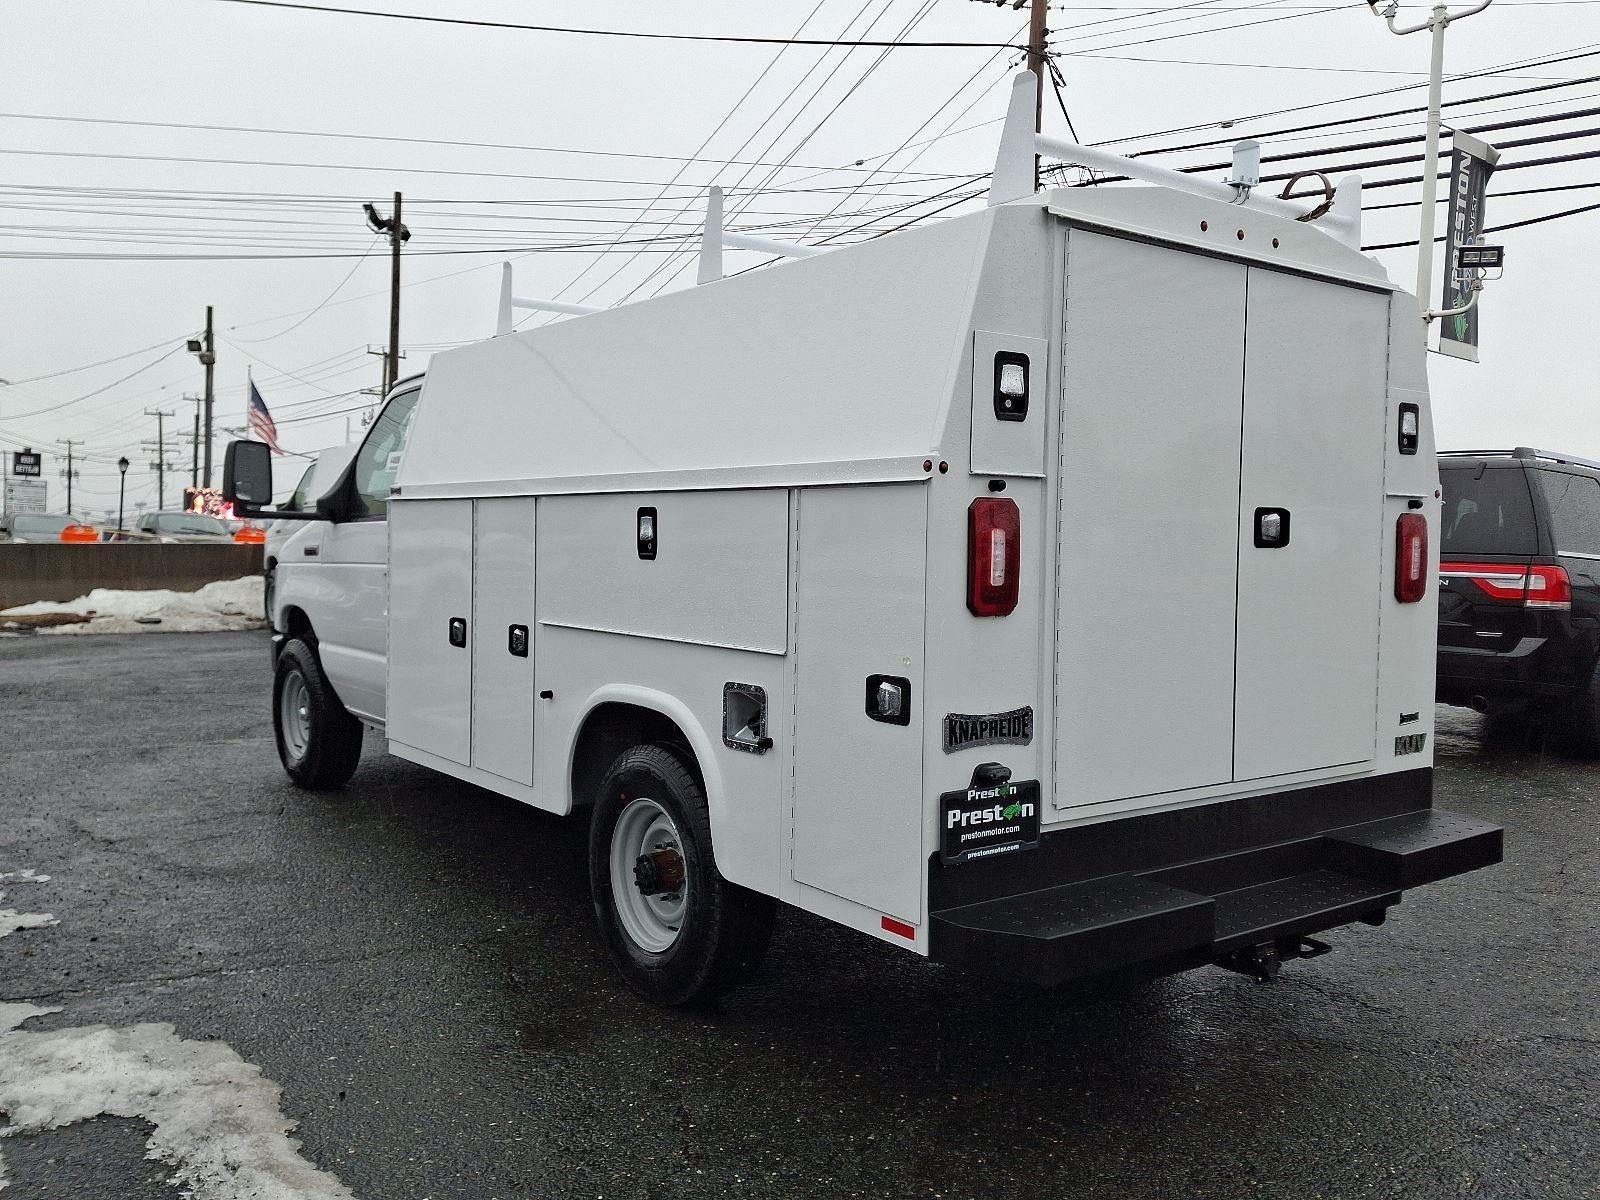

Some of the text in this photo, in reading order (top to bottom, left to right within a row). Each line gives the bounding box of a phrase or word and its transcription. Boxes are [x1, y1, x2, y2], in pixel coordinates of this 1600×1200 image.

[948, 712, 1030, 747] KNAPHEIDE
[960, 825, 1020, 843] prestonmotor.com
[967, 843, 1020, 860] prestonmotor.com
